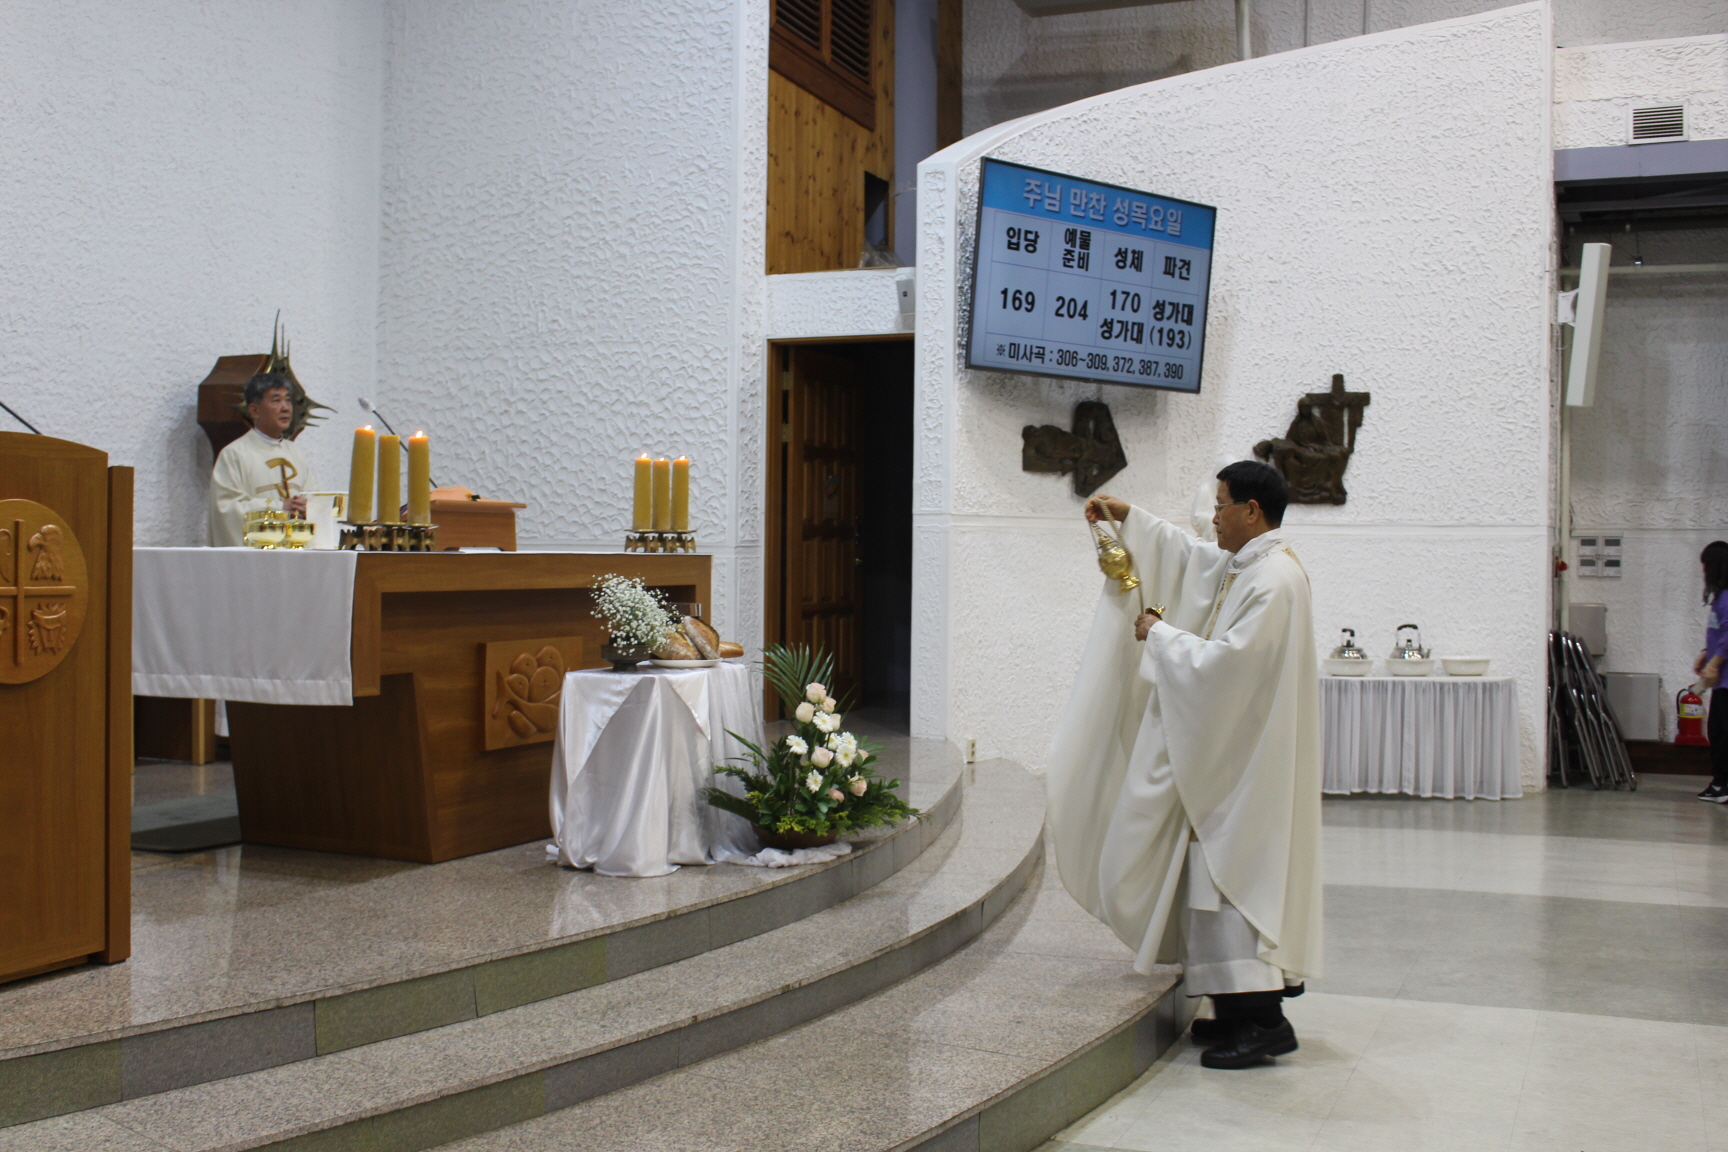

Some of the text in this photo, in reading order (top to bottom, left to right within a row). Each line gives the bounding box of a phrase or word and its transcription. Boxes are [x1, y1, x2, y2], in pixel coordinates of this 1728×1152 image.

[1023, 178, 1183, 236] 주님 만찬 성목요일
[1006, 227, 1039, 254] 입당
[1065, 228, 1092, 251] 예물
[1062, 249, 1089, 271] 준비
[1114, 247, 1143, 272] 성체
[1163, 255, 1191, 281] 파견
[1000, 288, 1036, 312] 169
[1054, 296, 1088, 320] 204
[1110, 289, 1141, 313] 170
[1152, 299, 1194, 326] 성가대
[1100, 318, 1144, 344] 성가대
[1149, 326, 1192, 350] (193)
[1009, 342, 1046, 364] 미사곡
[1164, 363, 1183, 379] 390
